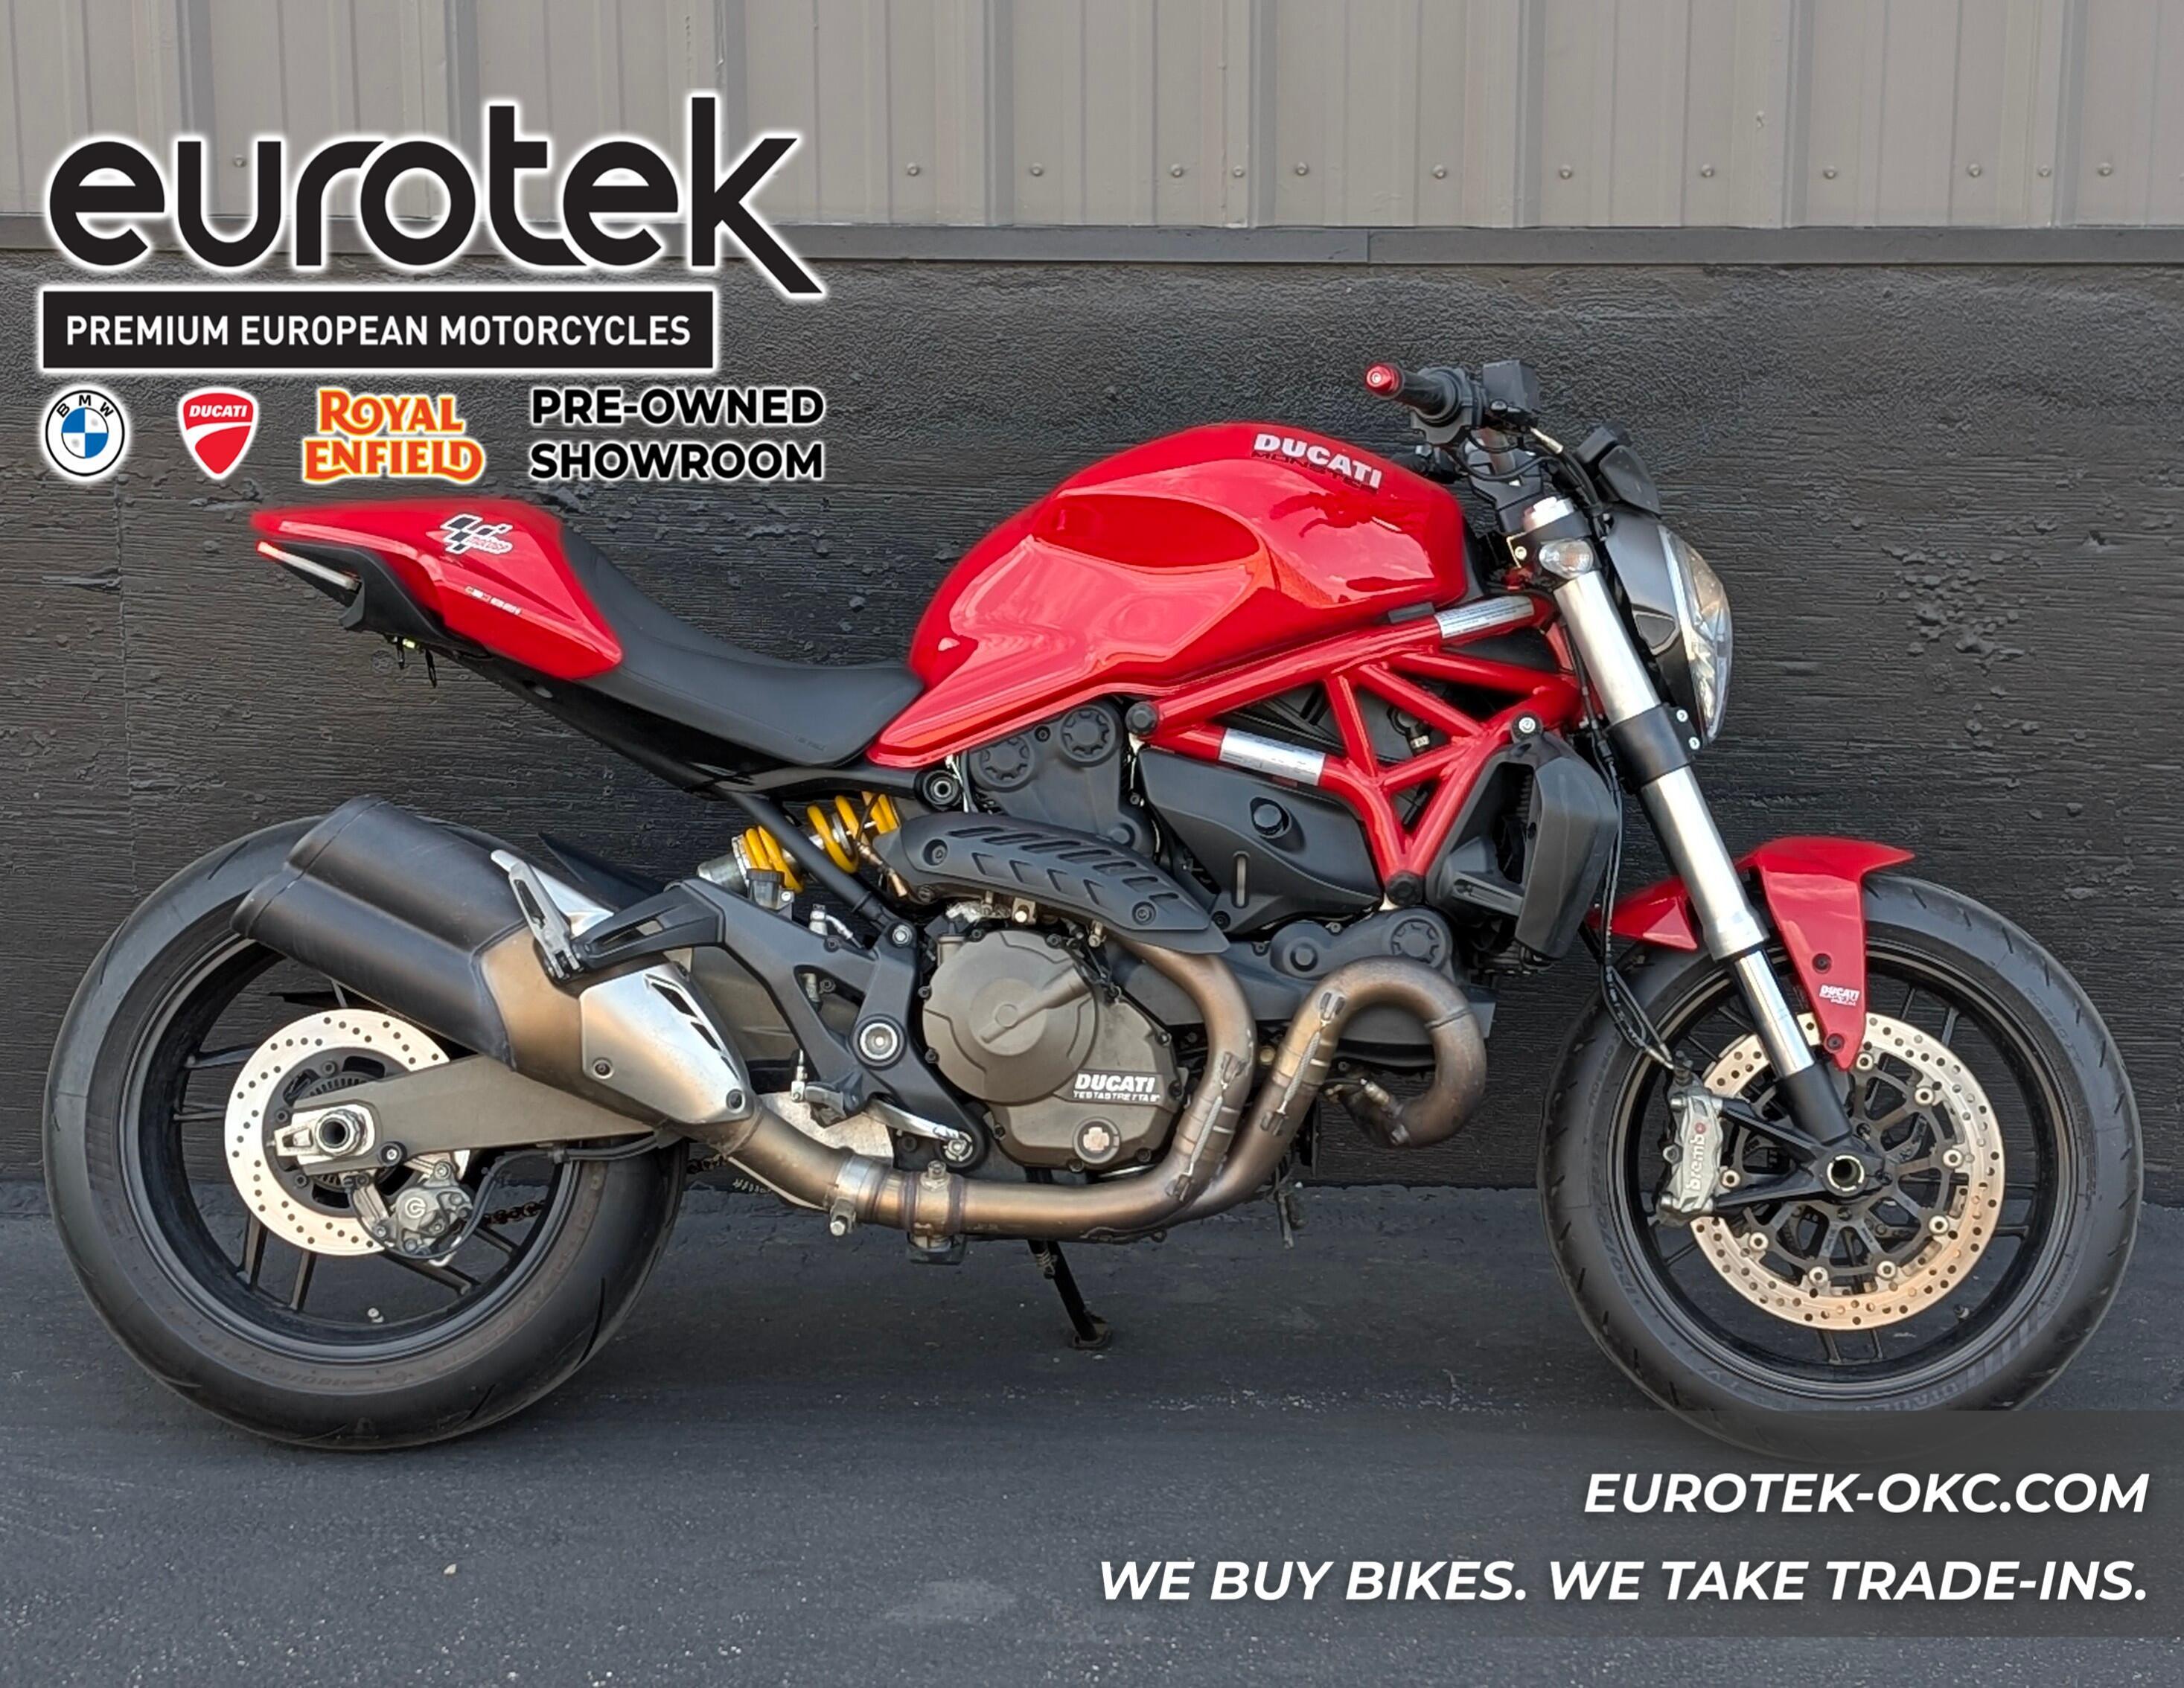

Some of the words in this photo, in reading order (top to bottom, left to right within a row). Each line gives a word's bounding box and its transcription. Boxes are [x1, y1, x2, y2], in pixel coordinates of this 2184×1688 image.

[1254, 433, 1382, 490] DUCATI
[1074, 1073, 1155, 1093] DUCATI
[1685, 1122, 1706, 1190] brembo
